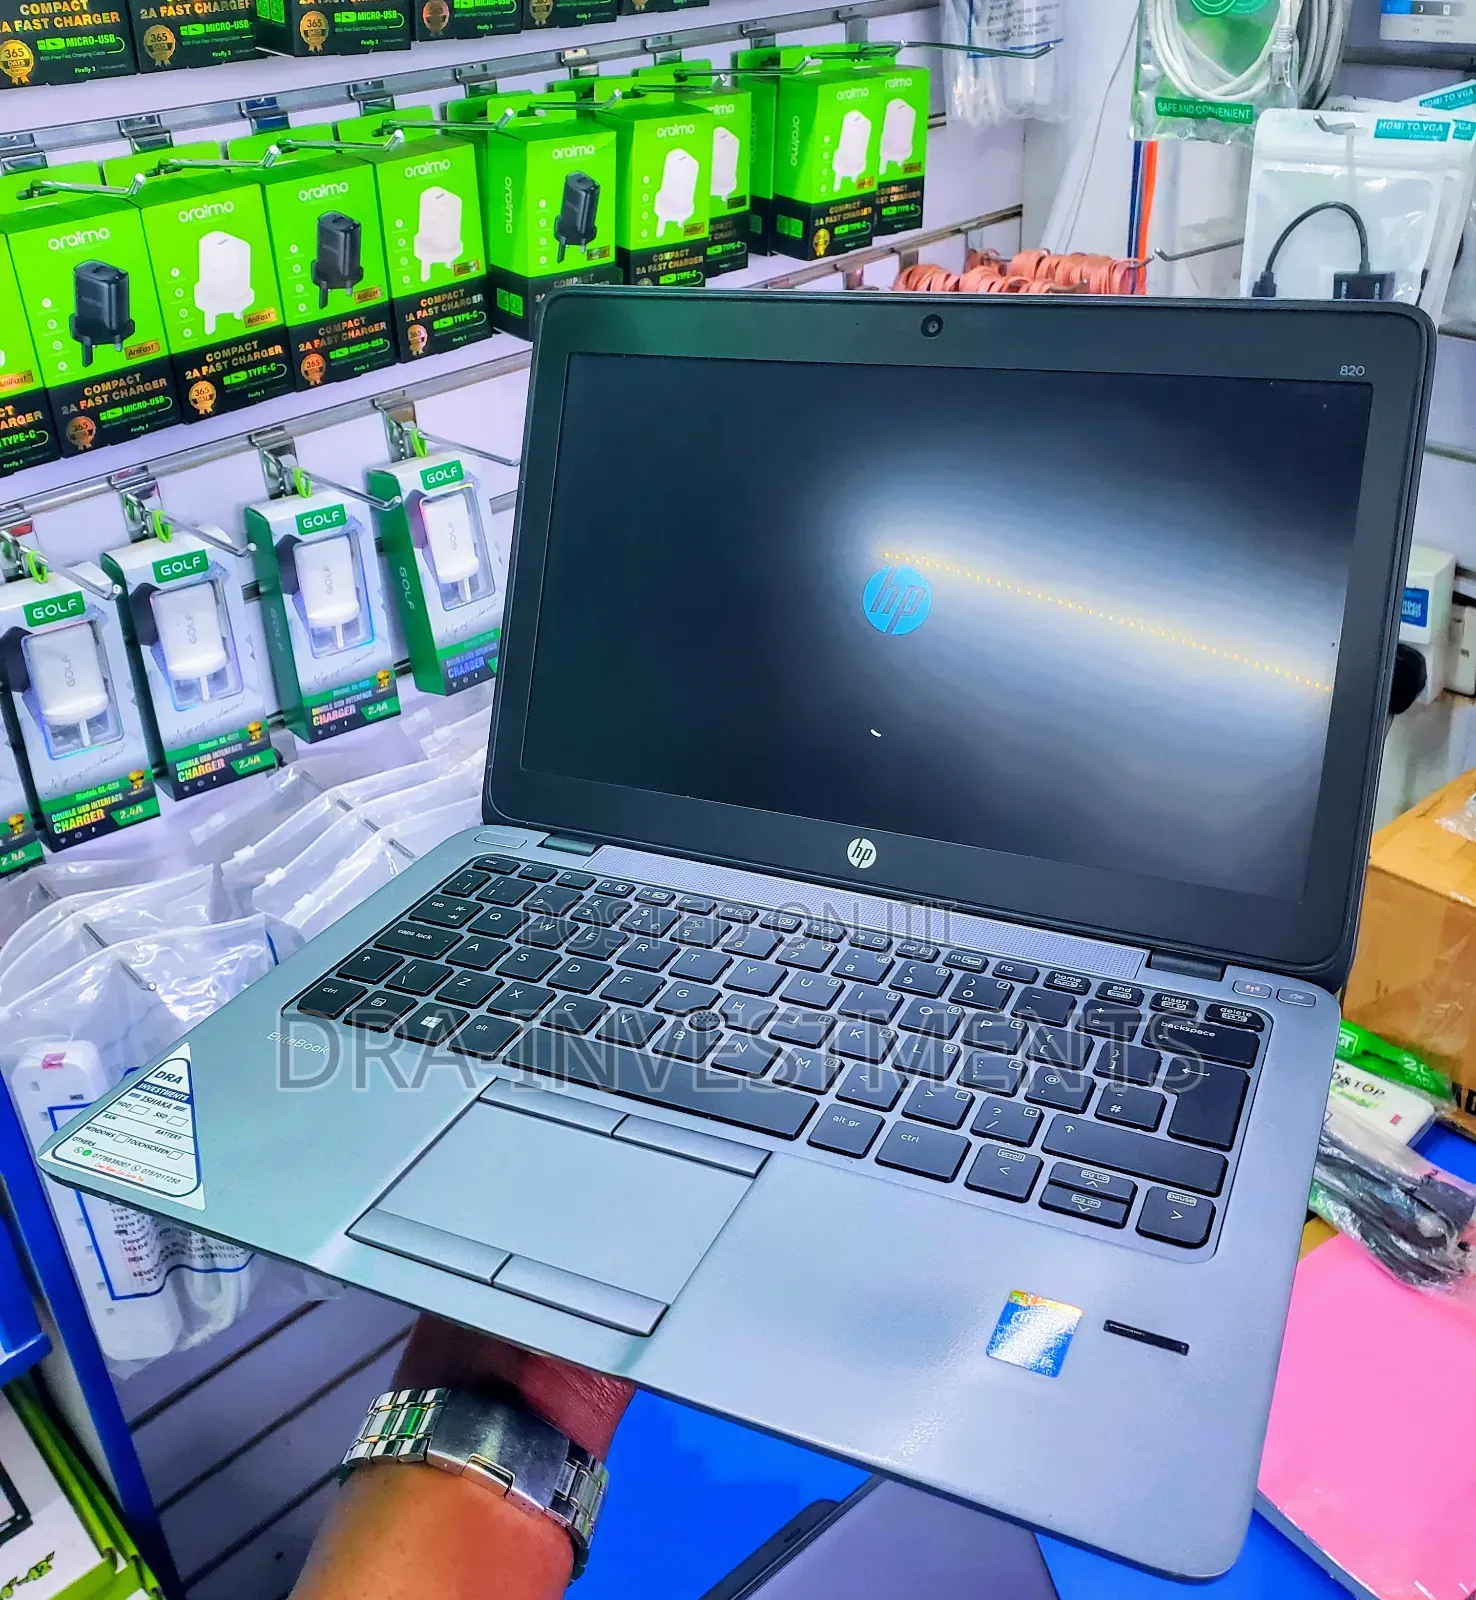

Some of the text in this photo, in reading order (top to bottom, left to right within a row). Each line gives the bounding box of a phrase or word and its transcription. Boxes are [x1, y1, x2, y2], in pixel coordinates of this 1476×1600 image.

[20, 0, 88, 15] COMPACT
[140, 3, 191, 19] 2A FAST
[14, 11, 120, 32] FAST CHARGER
[358, 10, 397, 20] MICRO-USB
[206, 20, 249, 33] MICRO-USB
[307, 19, 322, 28] 365
[66, 34, 115, 47] MICRO-USB
[150, 33, 168, 43] 365
[4, 48, 24, 58] 365
[837, 87, 869, 101] oraimo
[1444, 88, 1474, 102] TO VGA
[1157, 102, 1250, 119] SAFE AND CONVENIENT
[656, 124, 695, 138] oraimo
[1406, 122, 1421, 130] TO
[1422, 123, 1443, 132] VGA
[791, 116, 800, 166] oraimo
[552, 144, 595, 160] oraimo
[404, 159, 451, 178] oraimo
[298, 181, 349, 201] oraimo
[178, 201, 234, 222] oraimo
[504, 176, 513, 234] oraimo
[48, 227, 110, 251] oraimo
[648, 262, 667, 273] FAST
[420, 289, 465, 307] COMPACT
[442, 294, 484, 313] CHARGER
[454, 311, 478, 323] TYPE-C
[318, 316, 367, 337] COMPACT
[298, 322, 387, 352] 2A FAST CHARGER
[128, 344, 155, 357] AniFast
[205, 340, 259, 362] COMPACT
[185, 344, 284, 380] 2A FAST CHARGER
[306, 359, 320, 368] 365
[247, 363, 277, 378] TYPE-C
[1340, 365, 1365, 378] 820
[84, 373, 141, 396] COMPACT
[61, 378, 167, 415] 2A FAST CHARGER
[194, 387, 210, 397] 365
[123, 395, 165, 414] MICRO-USB
[426, 466, 458, 484] GOLF
[302, 511, 340, 529] GOLF
[160, 556, 201, 576] GOLF
[322, 565, 333, 595] GOLF
[400, 566, 415, 610] GOLF
[865, 565, 929, 635] hp
[32, 598, 77, 620] GOLF
[185, 613, 197, 645] GOLF
[61, 655, 76, 687] GOLF
[312, 704, 356, 727] CHARGER
[177, 758, 225, 783] CHARGER
[119, 805, 144, 820] 2.4A
[53, 808, 106, 835] CHARGER
[849, 838, 876, 868] hp
[533, 898, 544, 906] 2
[489, 913, 502, 922] Q
[539, 921, 556, 931] W
[398, 927, 433, 941] caps lock
[585, 932, 598, 941] E
[467, 943, 480, 951] A
[637, 943, 649, 952] R
[517, 953, 529, 962] S
[690, 954, 700, 962] T
[567, 965, 581, 973] D
[747, 966, 757, 975] Y
[845, 964, 855, 973] 8
[457, 978, 472, 987] Z
[619, 976, 634, 984] F
[801, 978, 813, 987] U
[903, 977, 913, 985] 9
[1055, 973, 1082, 982] home
[322, 986, 339, 995] ctrl
[508, 989, 524, 999] X
[676, 989, 690, 998] G
[732, 1001, 746, 1011] H
[1162, 995, 1189, 1005] insert
[563, 1003, 577, 1012] C
[919, 1006, 933, 1015] O
[1220, 1007, 1252, 1017] delete
[620, 1015, 633, 1024] V
[789, 1015, 800, 1025] J
[475, 1023, 488, 1031] alt
[1161, 1021, 1215, 1037] backspace
[673, 1031, 686, 1040] B
[849, 1029, 864, 1039] K
[266, 1031, 329, 1055] EliteBook
[733, 1042, 748, 1052] N
[912, 1042, 922, 1054] L
[795, 1057, 812, 1068] M
[154, 1071, 183, 1084] DRA
[138, 1083, 190, 1101] INVESTMENTS
[140, 1096, 173, 1109] ISHAKA
[833, 1114, 861, 1128] alt gr
[86, 1126, 169, 1154] WINDOWS TOUCHSCREEN
[155, 1129, 182, 1140] BATTERY
[901, 1134, 920, 1143] ctrl
[72, 1136, 96, 1147] OTHERS
[1000, 1150, 1024, 1160] scroll
[1168, 1193, 1196, 1205] pause
